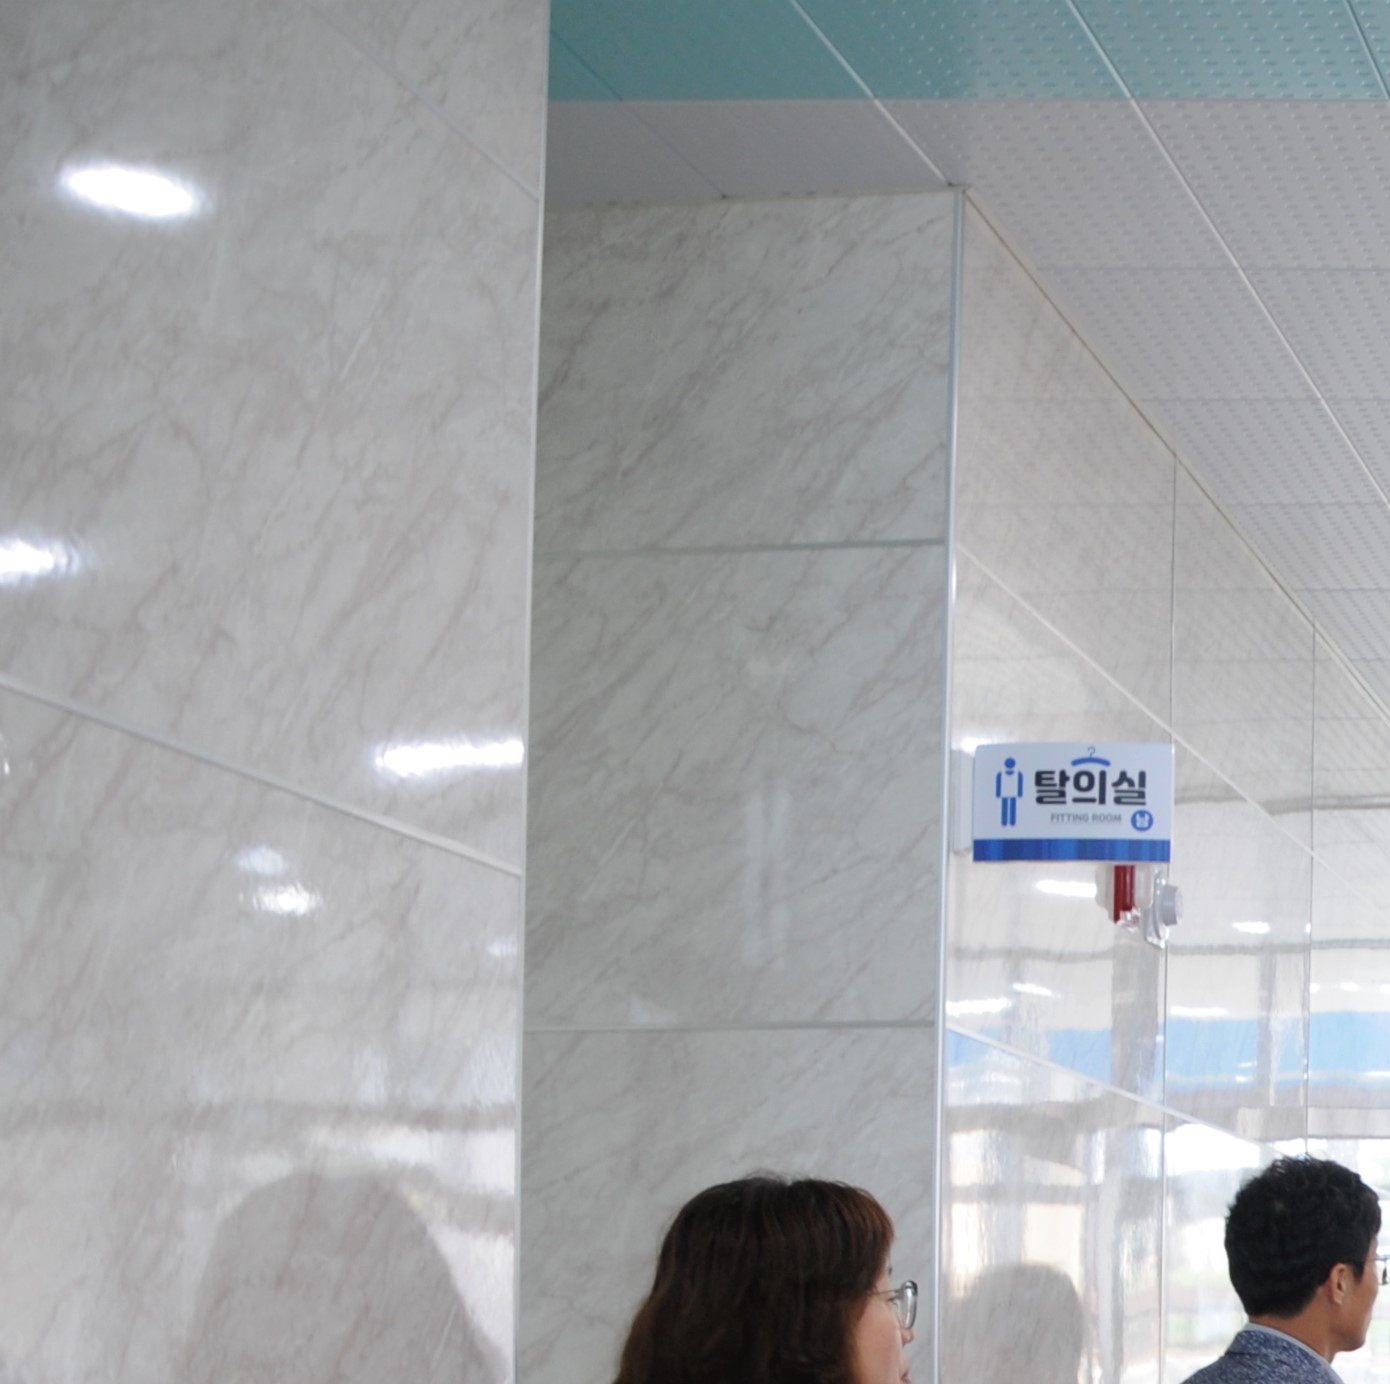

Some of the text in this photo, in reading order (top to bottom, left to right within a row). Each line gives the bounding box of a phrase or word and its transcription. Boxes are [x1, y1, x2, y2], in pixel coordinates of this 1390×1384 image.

[1035, 769, 1146, 805] 탈의실
[1050, 813, 1122, 823] FITTING ROOM
